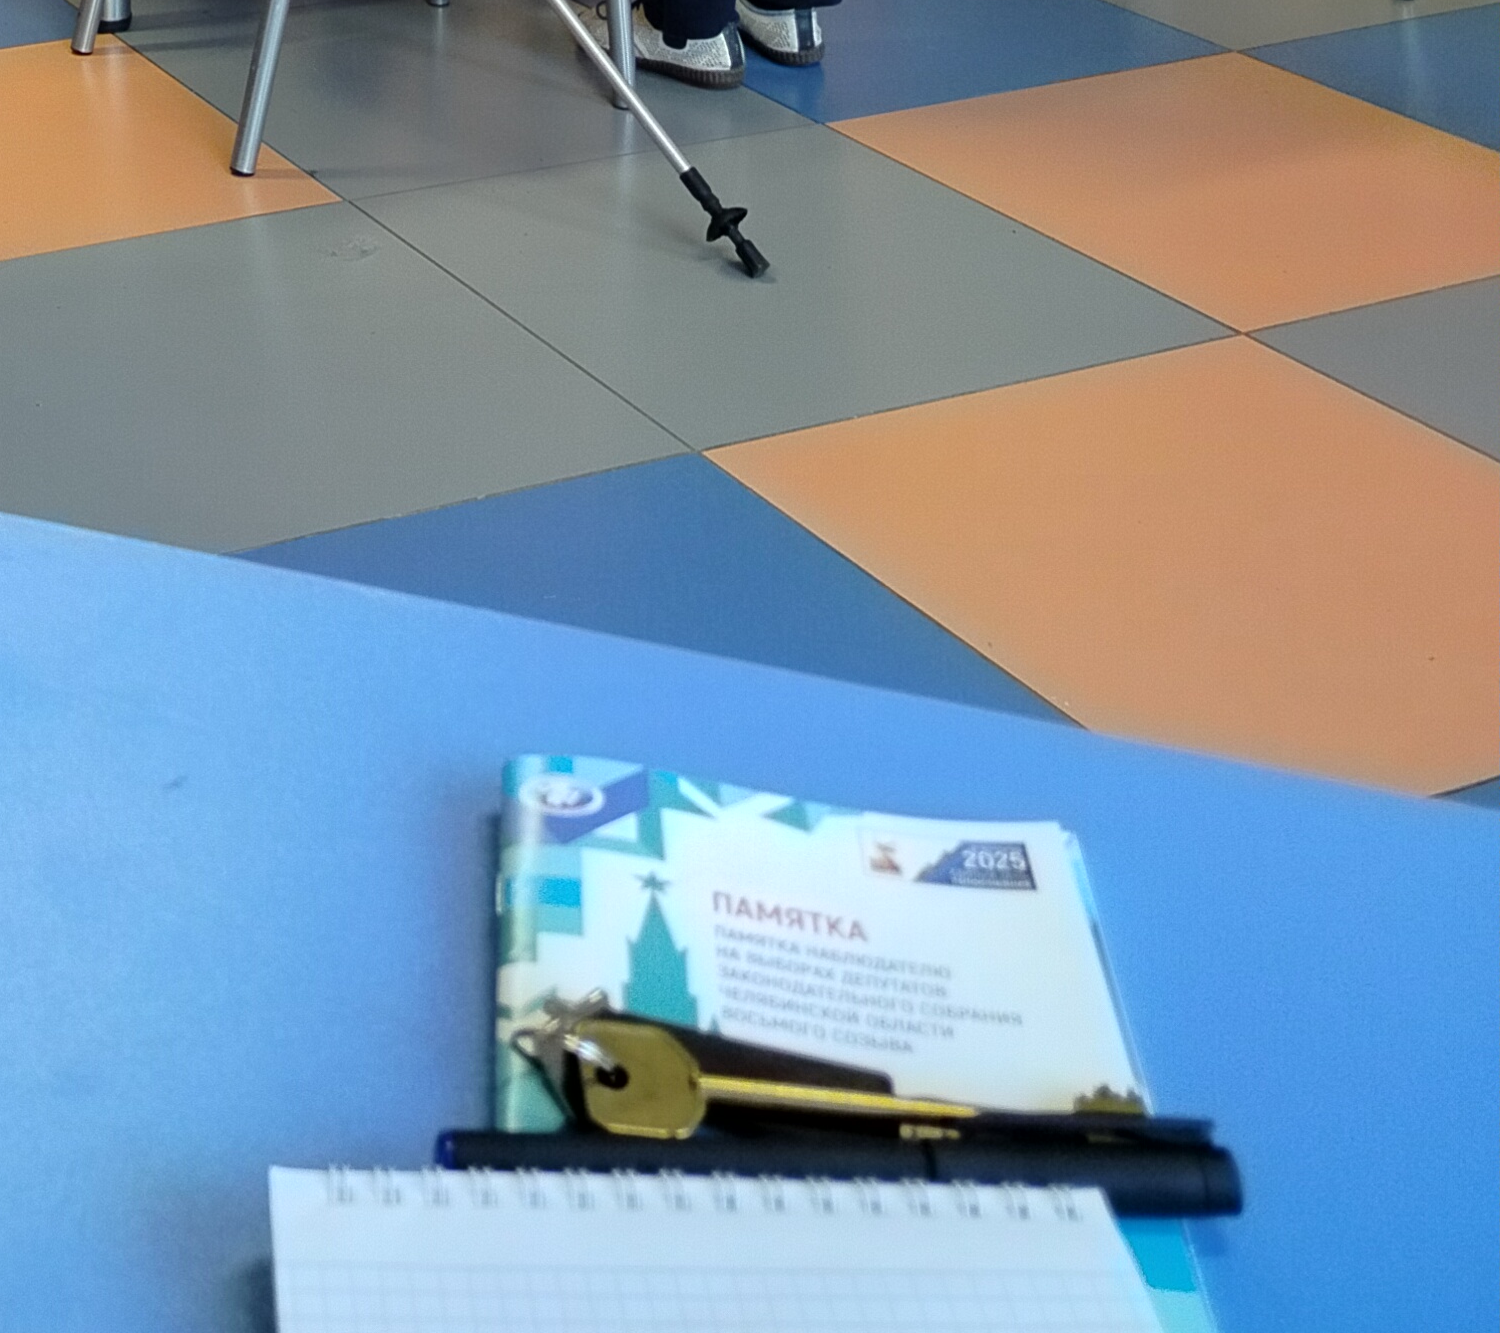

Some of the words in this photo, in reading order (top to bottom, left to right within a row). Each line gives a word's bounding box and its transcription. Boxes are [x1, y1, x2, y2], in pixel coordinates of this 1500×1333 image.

[961, 849, 1027, 872] 2025
[712, 890, 869, 943] ПАМЯТКА
[714, 923, 800, 955] ПАМЯТКА
[716, 945, 741, 962] НА
